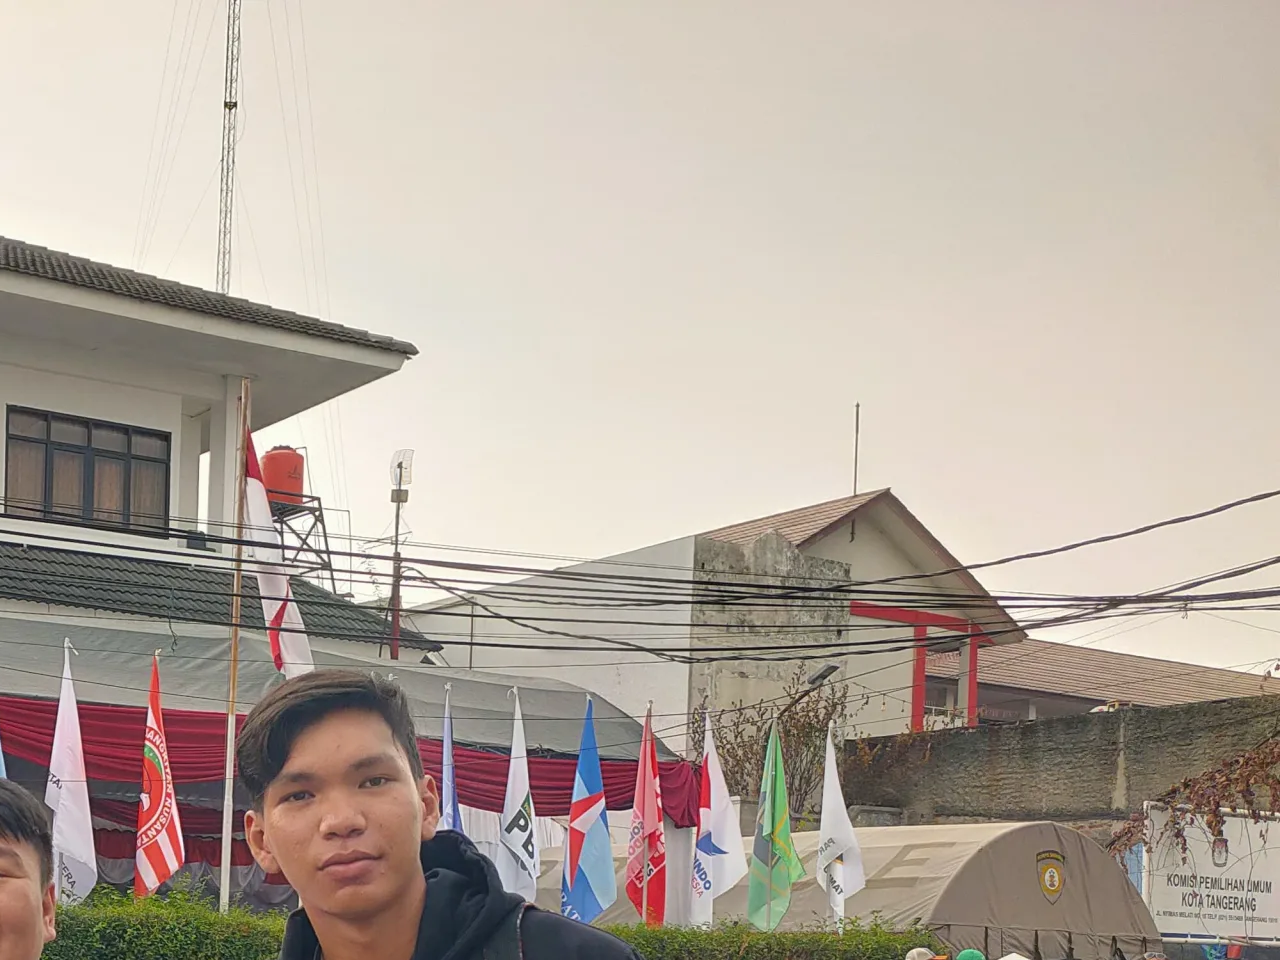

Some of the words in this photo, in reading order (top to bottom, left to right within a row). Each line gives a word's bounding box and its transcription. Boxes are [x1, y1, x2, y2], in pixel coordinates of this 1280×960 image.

[1167, 873, 1197, 888] KOMISI
[1200, 876, 1245, 891] PEMILIHAN
[1247, 880, 1272, 894] UMUM
[1182, 892, 1204, 908] KOTA
[1206, 894, 1256, 911] TANGERANG
